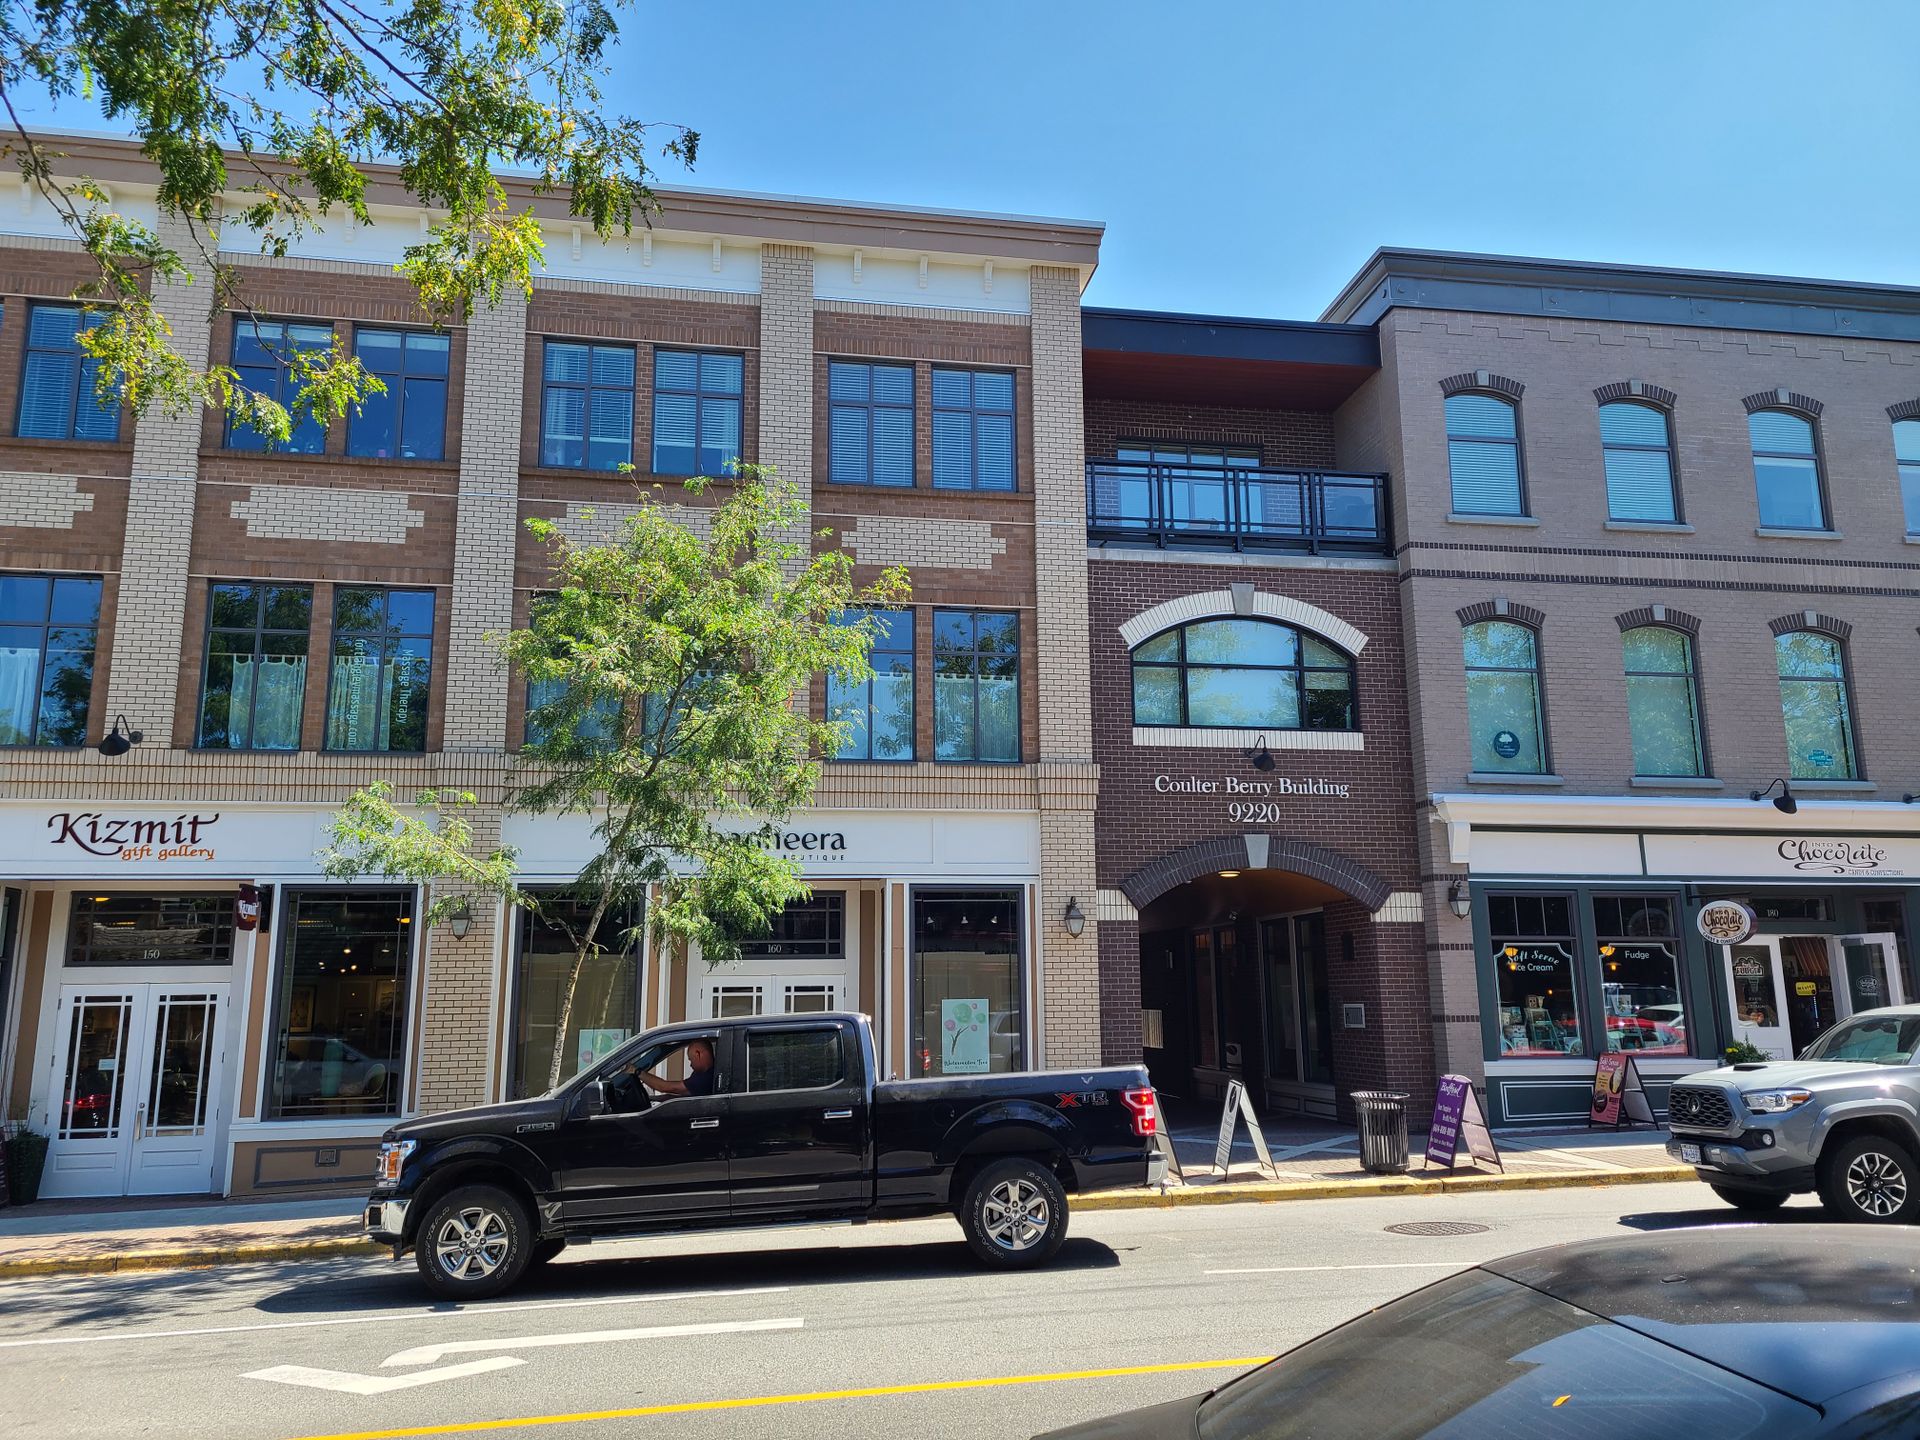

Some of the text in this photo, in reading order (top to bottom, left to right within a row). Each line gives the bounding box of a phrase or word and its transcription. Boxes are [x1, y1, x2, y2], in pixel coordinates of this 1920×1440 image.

[396, 648, 414, 724] Massage Therapy
[1154, 775, 1350, 799] Coulter Berry Building
[1228, 802, 1280, 823] 9220
[47, 812, 220, 857] Kizmit
[121, 844, 215, 861] gift gallery
[1778, 839, 1888, 867] Chocolate
[1703, 908, 1744, 929] Chocolate
[142, 949, 161, 960] 150
[767, 944, 782, 954] 160
[1532, 950, 1560, 966] Serve
[1625, 950, 1650, 960] Fudge
[1527, 963, 1554, 971] Cream
